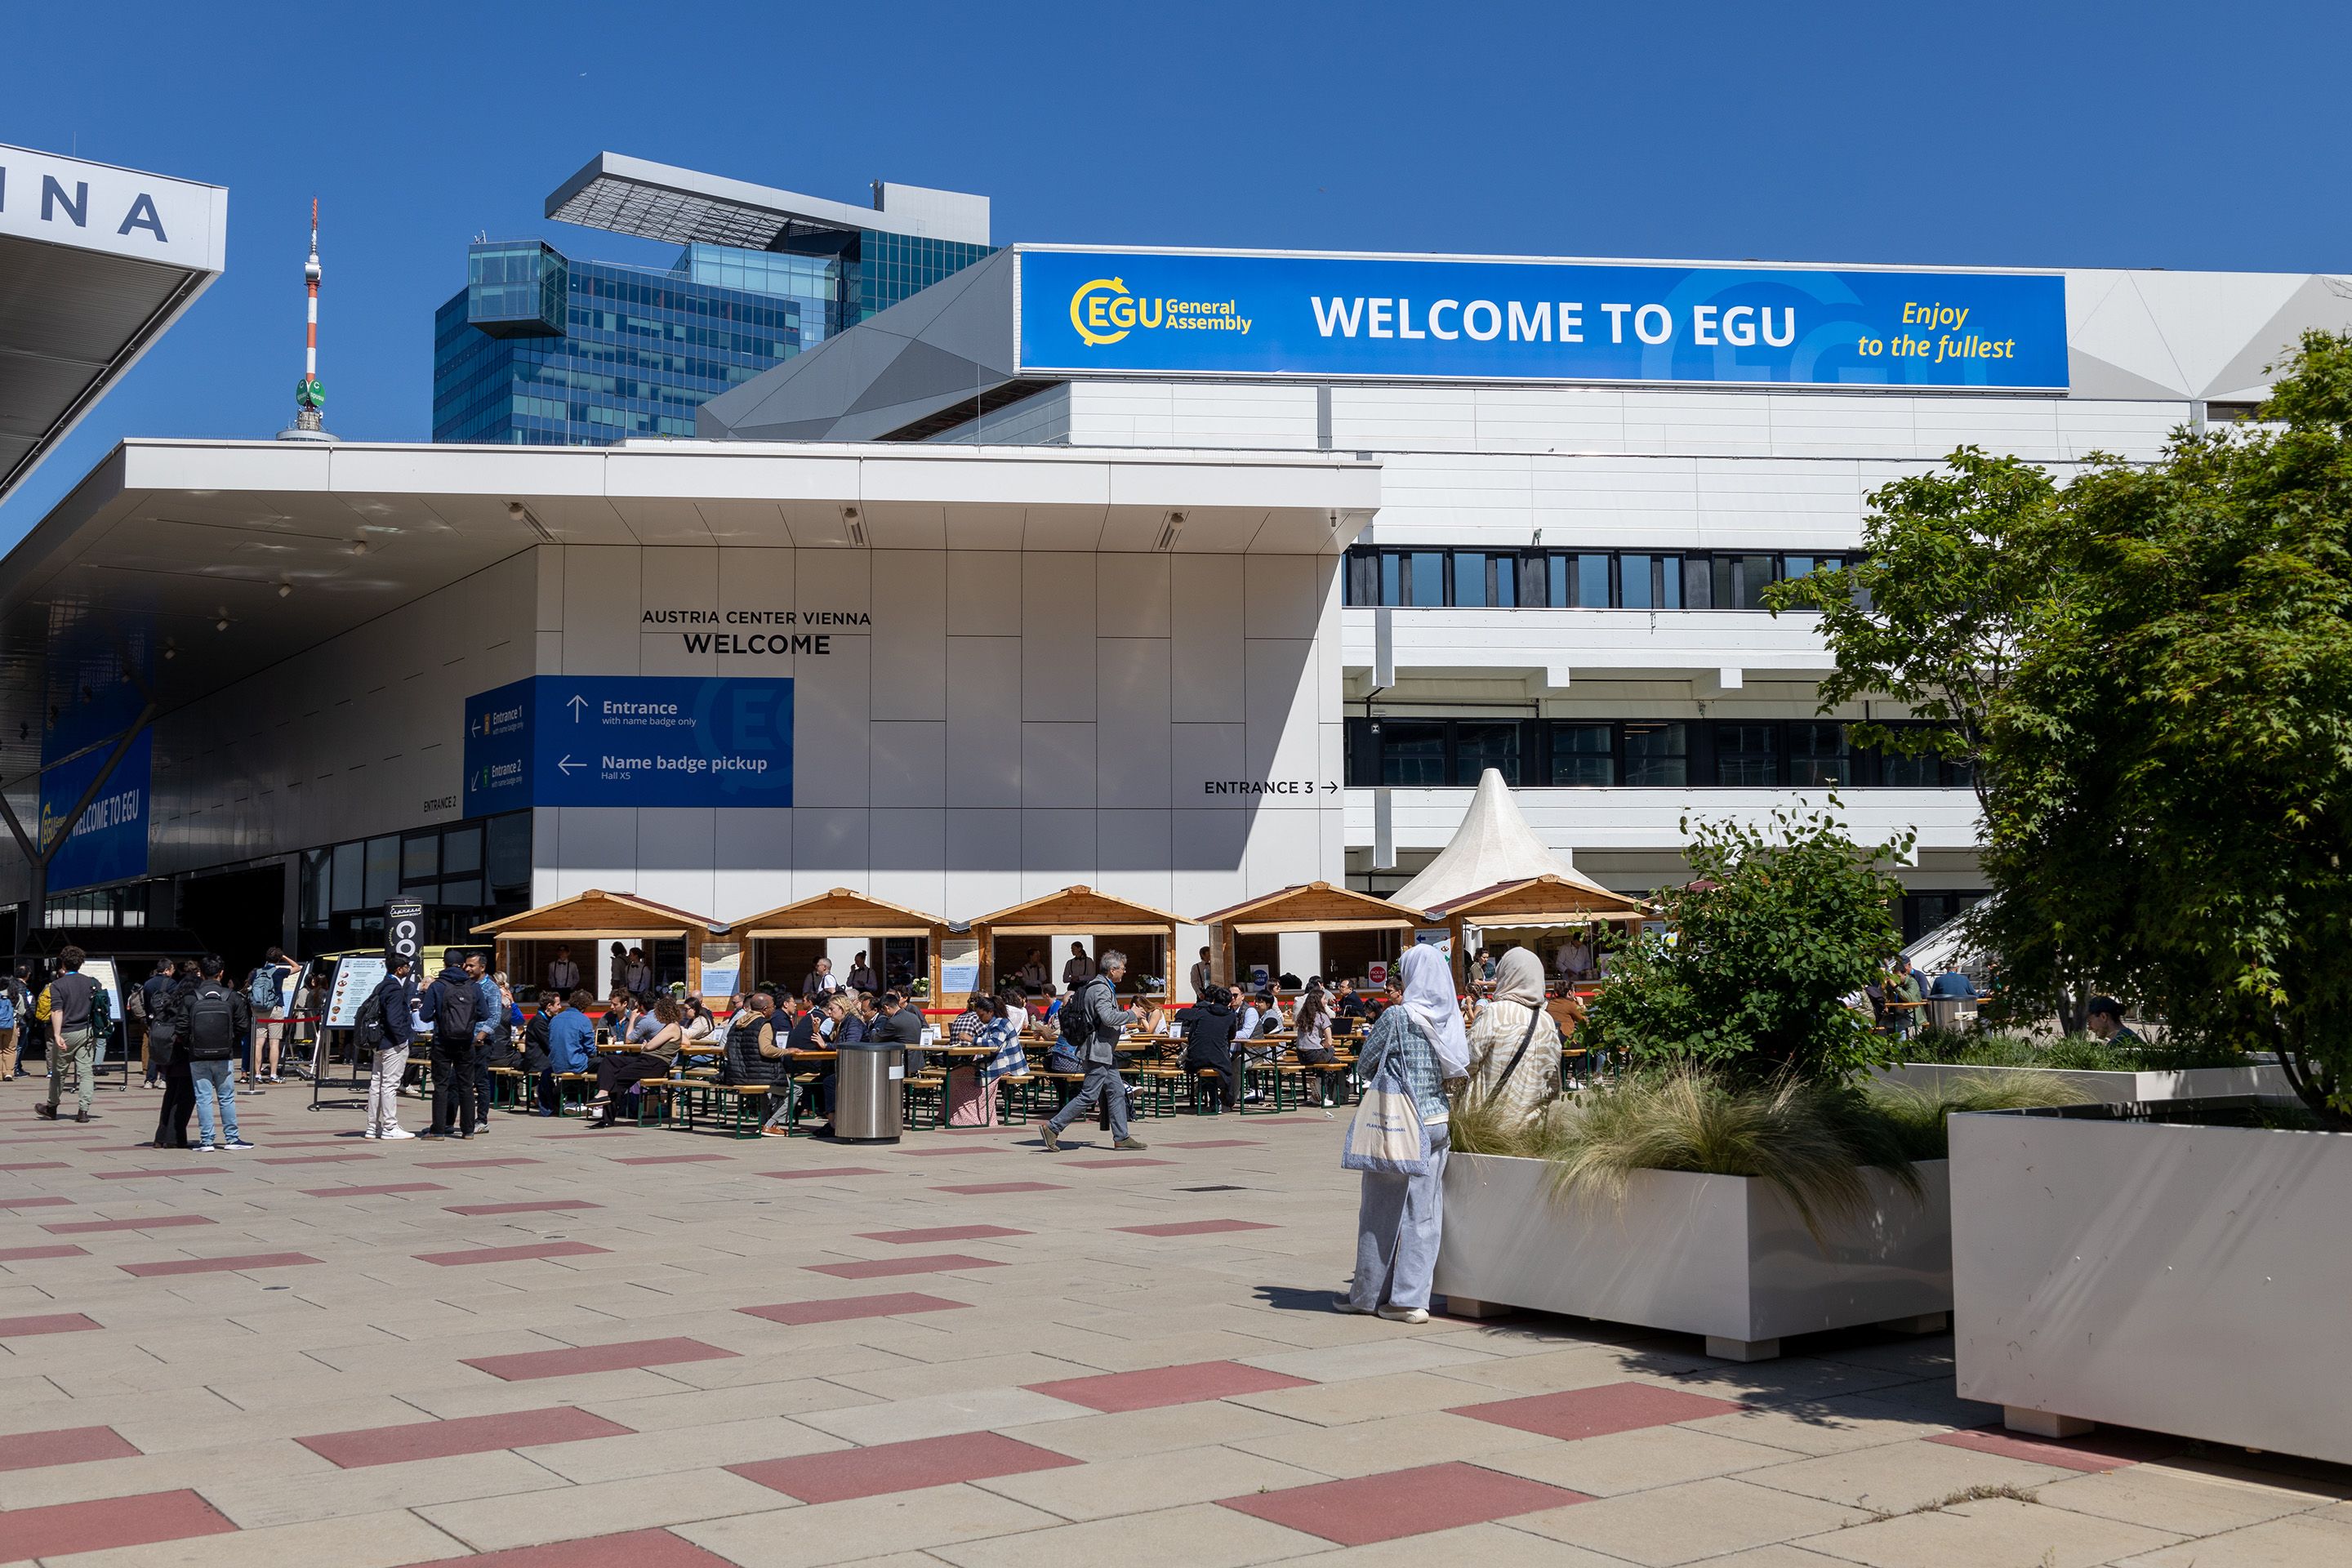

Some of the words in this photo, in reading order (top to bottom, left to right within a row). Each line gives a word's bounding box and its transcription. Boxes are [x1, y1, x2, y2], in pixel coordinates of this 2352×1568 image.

[0, 167, 168, 243] NA
[1089, 296, 1162, 328] EGU
[1165, 299, 1235, 314] General
[1902, 301, 1969, 330] Enjoy
[1165, 314, 1252, 335] Assembly
[1311, 296, 1584, 342] WELCOME
[1601, 303, 1673, 345] TO
[1694, 305, 1795, 347] EGU
[1858, 336, 1882, 356] to
[1891, 334, 1930, 356] the
[1935, 335, 2016, 363] fullest
[642, 610, 719, 624] AUSTRIA
[726, 611, 796, 624] CENTER
[803, 612, 871, 626] VIENNA
[684, 634, 831, 655] WELCOME
[492, 708, 518, 725] Entrance
[519, 705, 523, 718] 1
[603, 701, 678, 715] Entrance
[602, 717, 621, 725] with
[649, 718, 676, 727] badge
[678, 718, 697, 728] only
[492, 762, 517, 777] Entrance
[517, 759, 522, 773] 2
[602, 755, 652, 769] Name
[657, 755, 707, 773] badge
[711, 756, 768, 774] pickup
[601, 772, 617, 780] Hall
[620, 772, 631, 780] X5
[1205, 782, 1298, 794] ENTRANCE
[1304, 782, 1313, 794] 3
[109, 795, 120, 826] TO
[122, 788, 139, 822] EGU
[424, 796, 452, 812] ENTRANCE
[453, 795, 457, 807] 2
[43, 817, 56, 844] EGU
